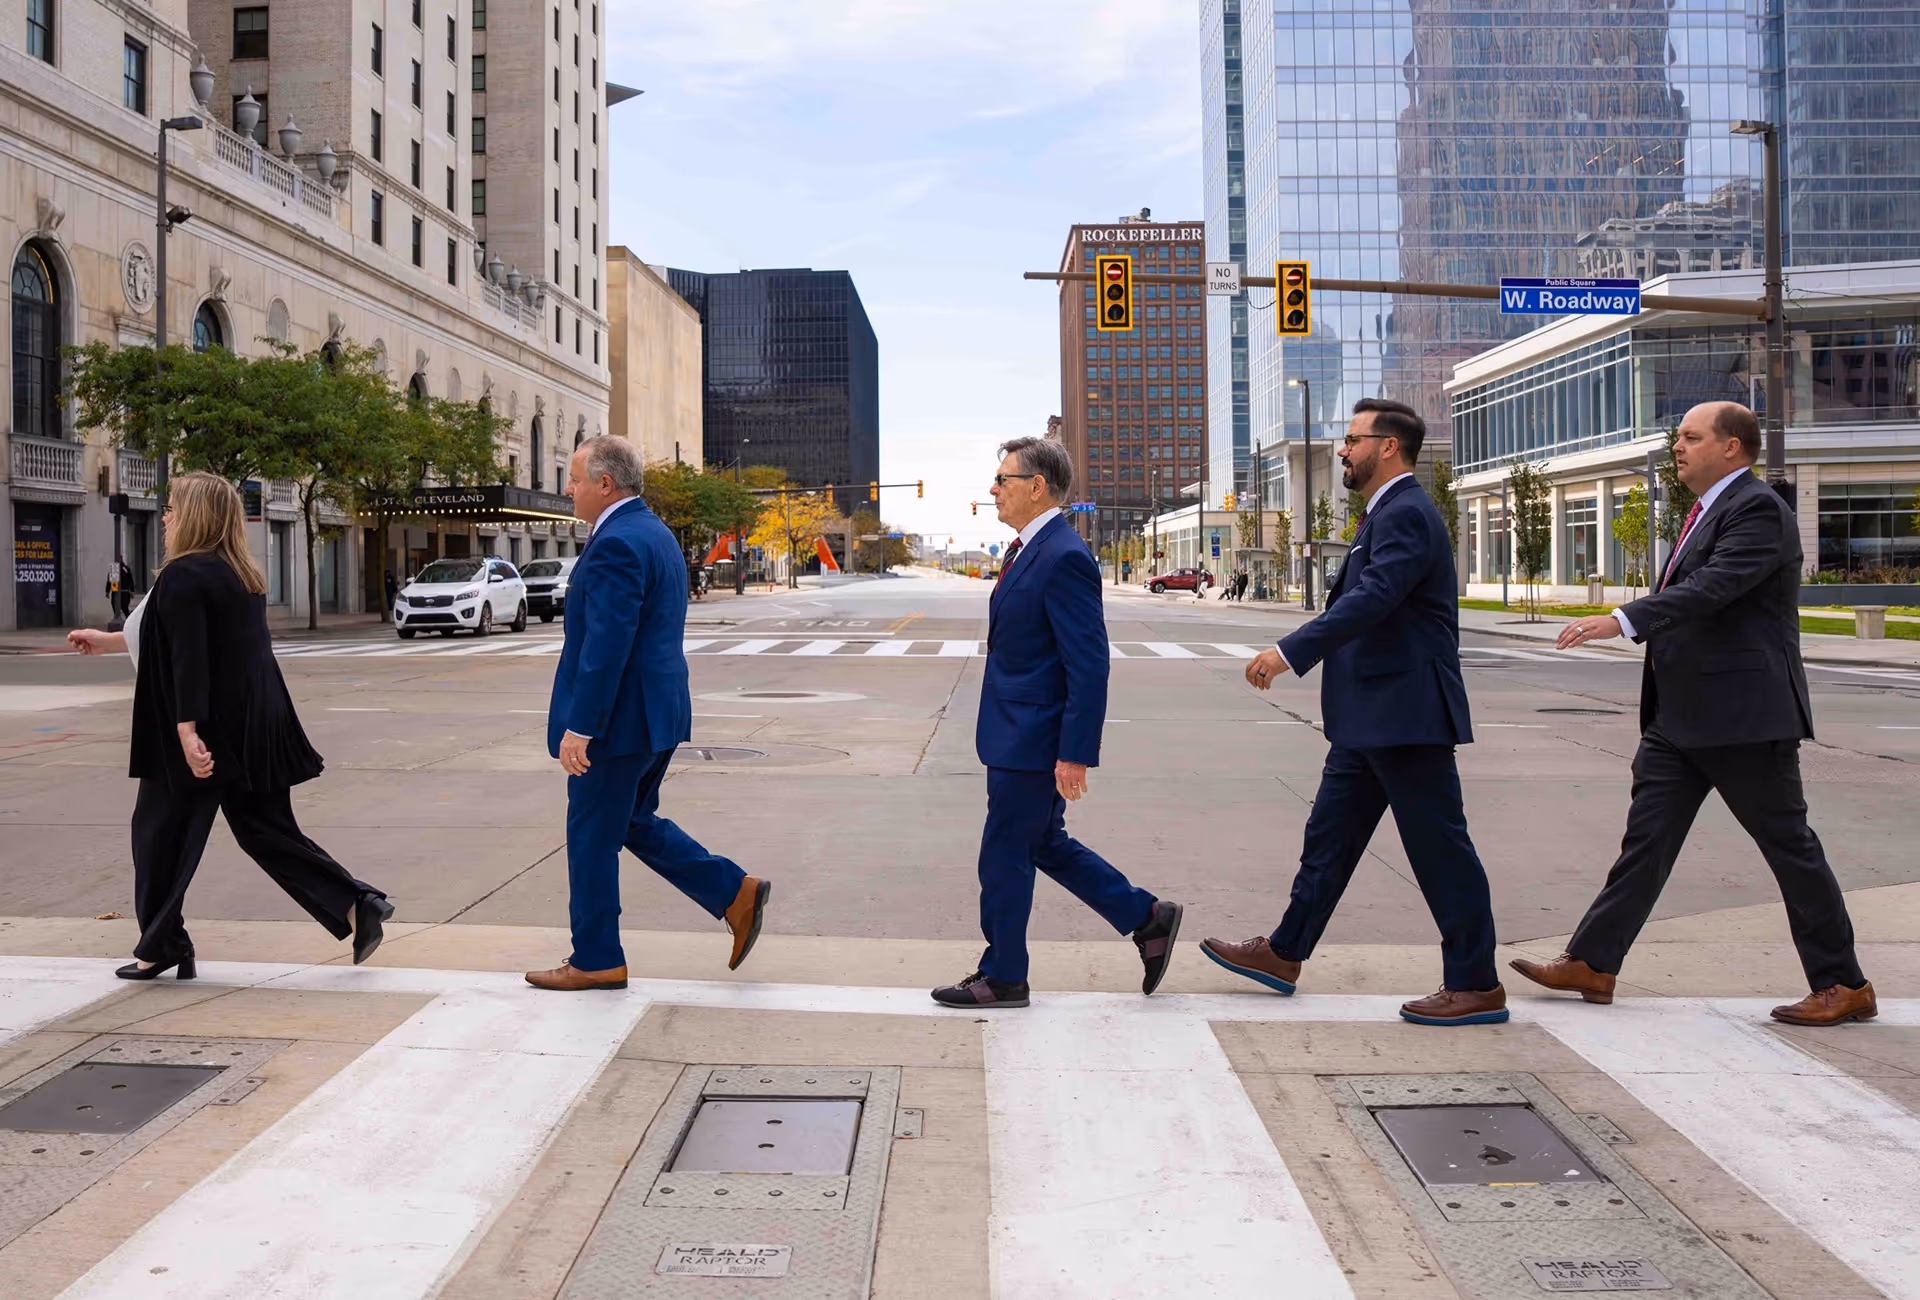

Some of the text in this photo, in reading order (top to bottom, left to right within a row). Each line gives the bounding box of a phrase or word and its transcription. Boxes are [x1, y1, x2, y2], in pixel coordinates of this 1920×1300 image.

[1081, 228, 1202, 242] ROCKEFELLER
[1215, 268, 1231, 278] NO
[1209, 282, 1237, 290] TURNS
[1569, 279, 1596, 288] Square
[1504, 290, 1637, 313] W. Roadway
[414, 494, 485, 505] CLEVELAND
[31, 541, 50, 550] OFFICE
[37, 551, 54, 559] LEASE
[674, 1248, 780, 1257] HEALD
[680, 1256, 767, 1265] RAPTOR
[1534, 1260, 1643, 1270] HEALD
[1550, 1269, 1643, 1279] RAPTOR
